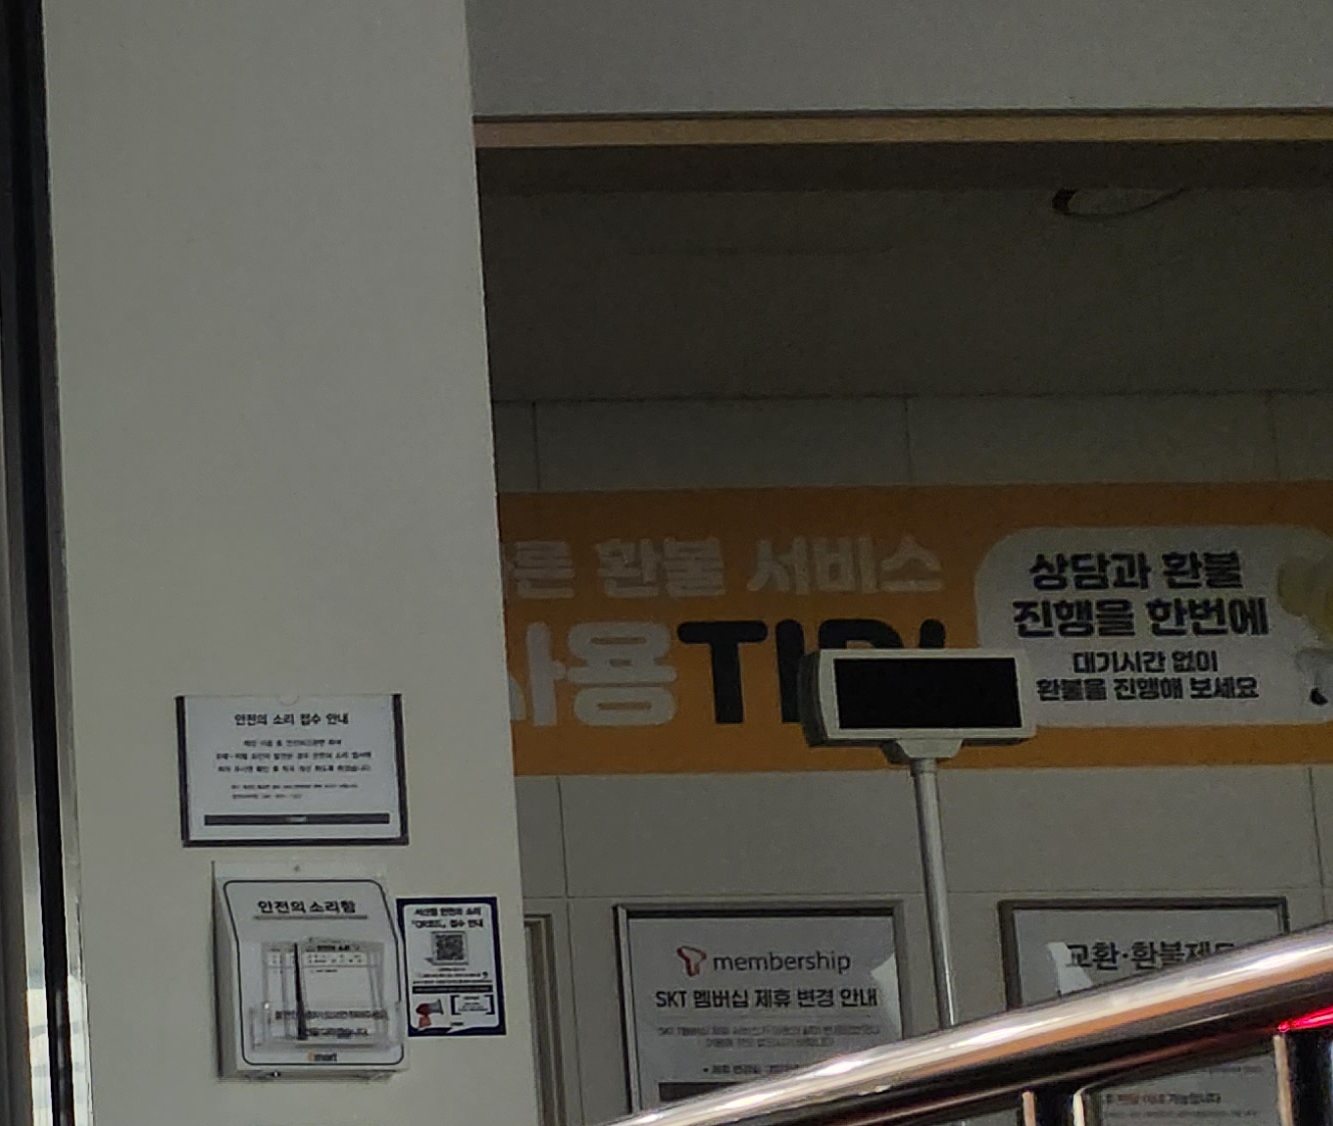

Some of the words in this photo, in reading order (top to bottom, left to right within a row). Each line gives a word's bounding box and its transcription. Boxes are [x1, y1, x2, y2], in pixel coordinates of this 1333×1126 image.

[502, 537, 576, 598] 른
[595, 536, 726, 598] 환불
[745, 533, 946, 596] 서비스
[1030, 550, 1151, 590] 상담과
[1162, 550, 1243, 589] 환불
[1013, 598, 1136, 638] 진행을
[1146, 597, 1270, 637] 한번에
[1073, 651, 1166, 674] 대기시간
[1171, 651, 1218, 673] 없이
[1037, 677, 1106, 701] 환불을
[1115, 676, 1183, 700] 진행해
[1190, 676, 1259, 700] 보세요
[235, 713, 268, 726] 안전의
[273, 714, 295, 725] 소리
[326, 713, 349, 725] 안내
[258, 900, 306, 914] 안전의
[310, 900, 356, 914] 소리함
[713, 952, 851, 974] membership
[655, 990, 687, 1008] SKT
[693, 988, 749, 1009] 멤버십
[754, 988, 790, 1008] 제휴
[797, 988, 833, 1008] 변경
[840, 988, 878, 1008] 안내
